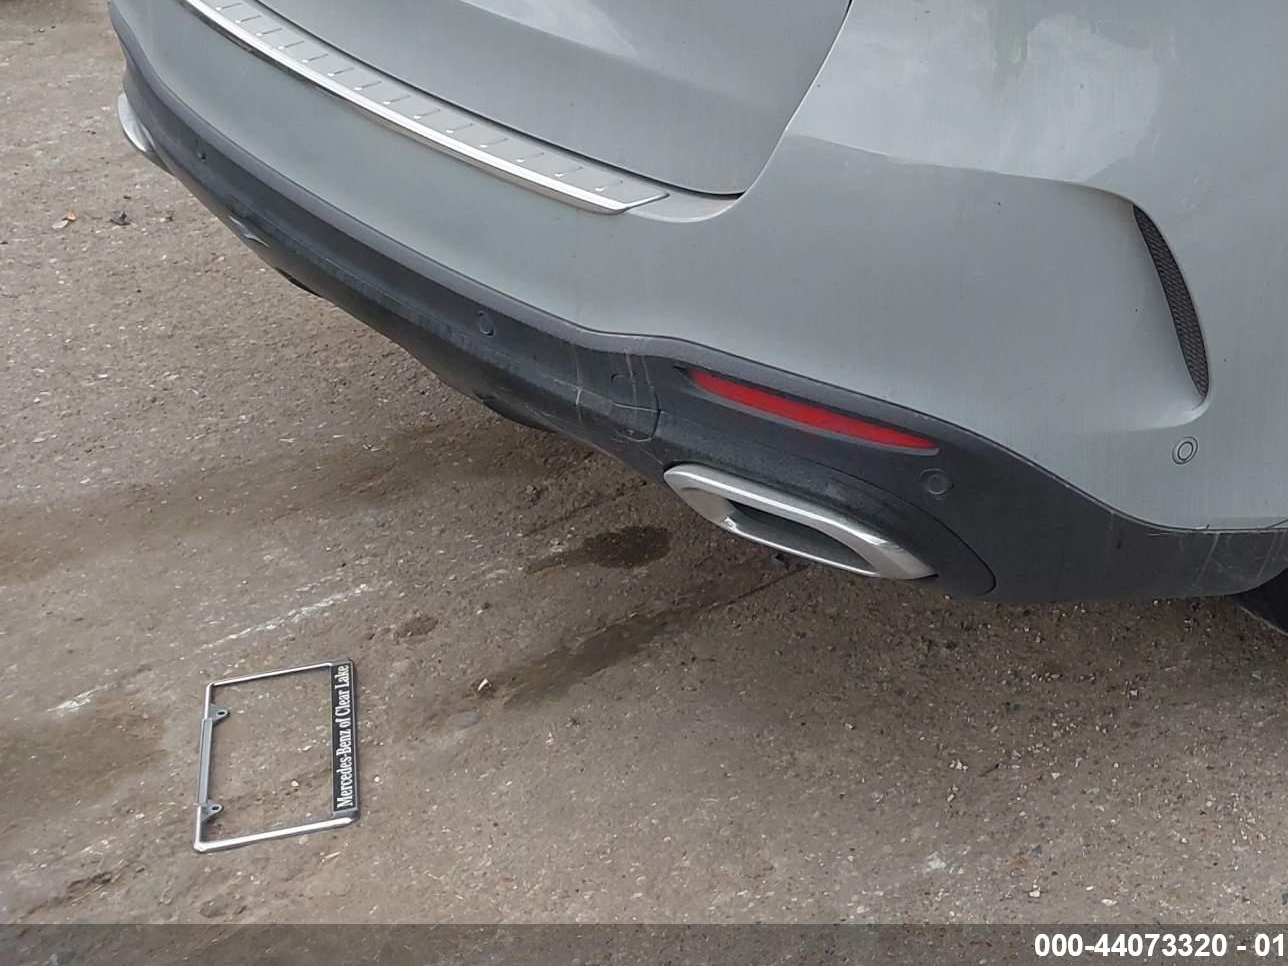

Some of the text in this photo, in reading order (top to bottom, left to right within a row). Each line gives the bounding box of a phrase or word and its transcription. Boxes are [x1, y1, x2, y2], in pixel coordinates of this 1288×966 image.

[334, 664, 354, 809] Mercedes-Benz of Clear Lake
